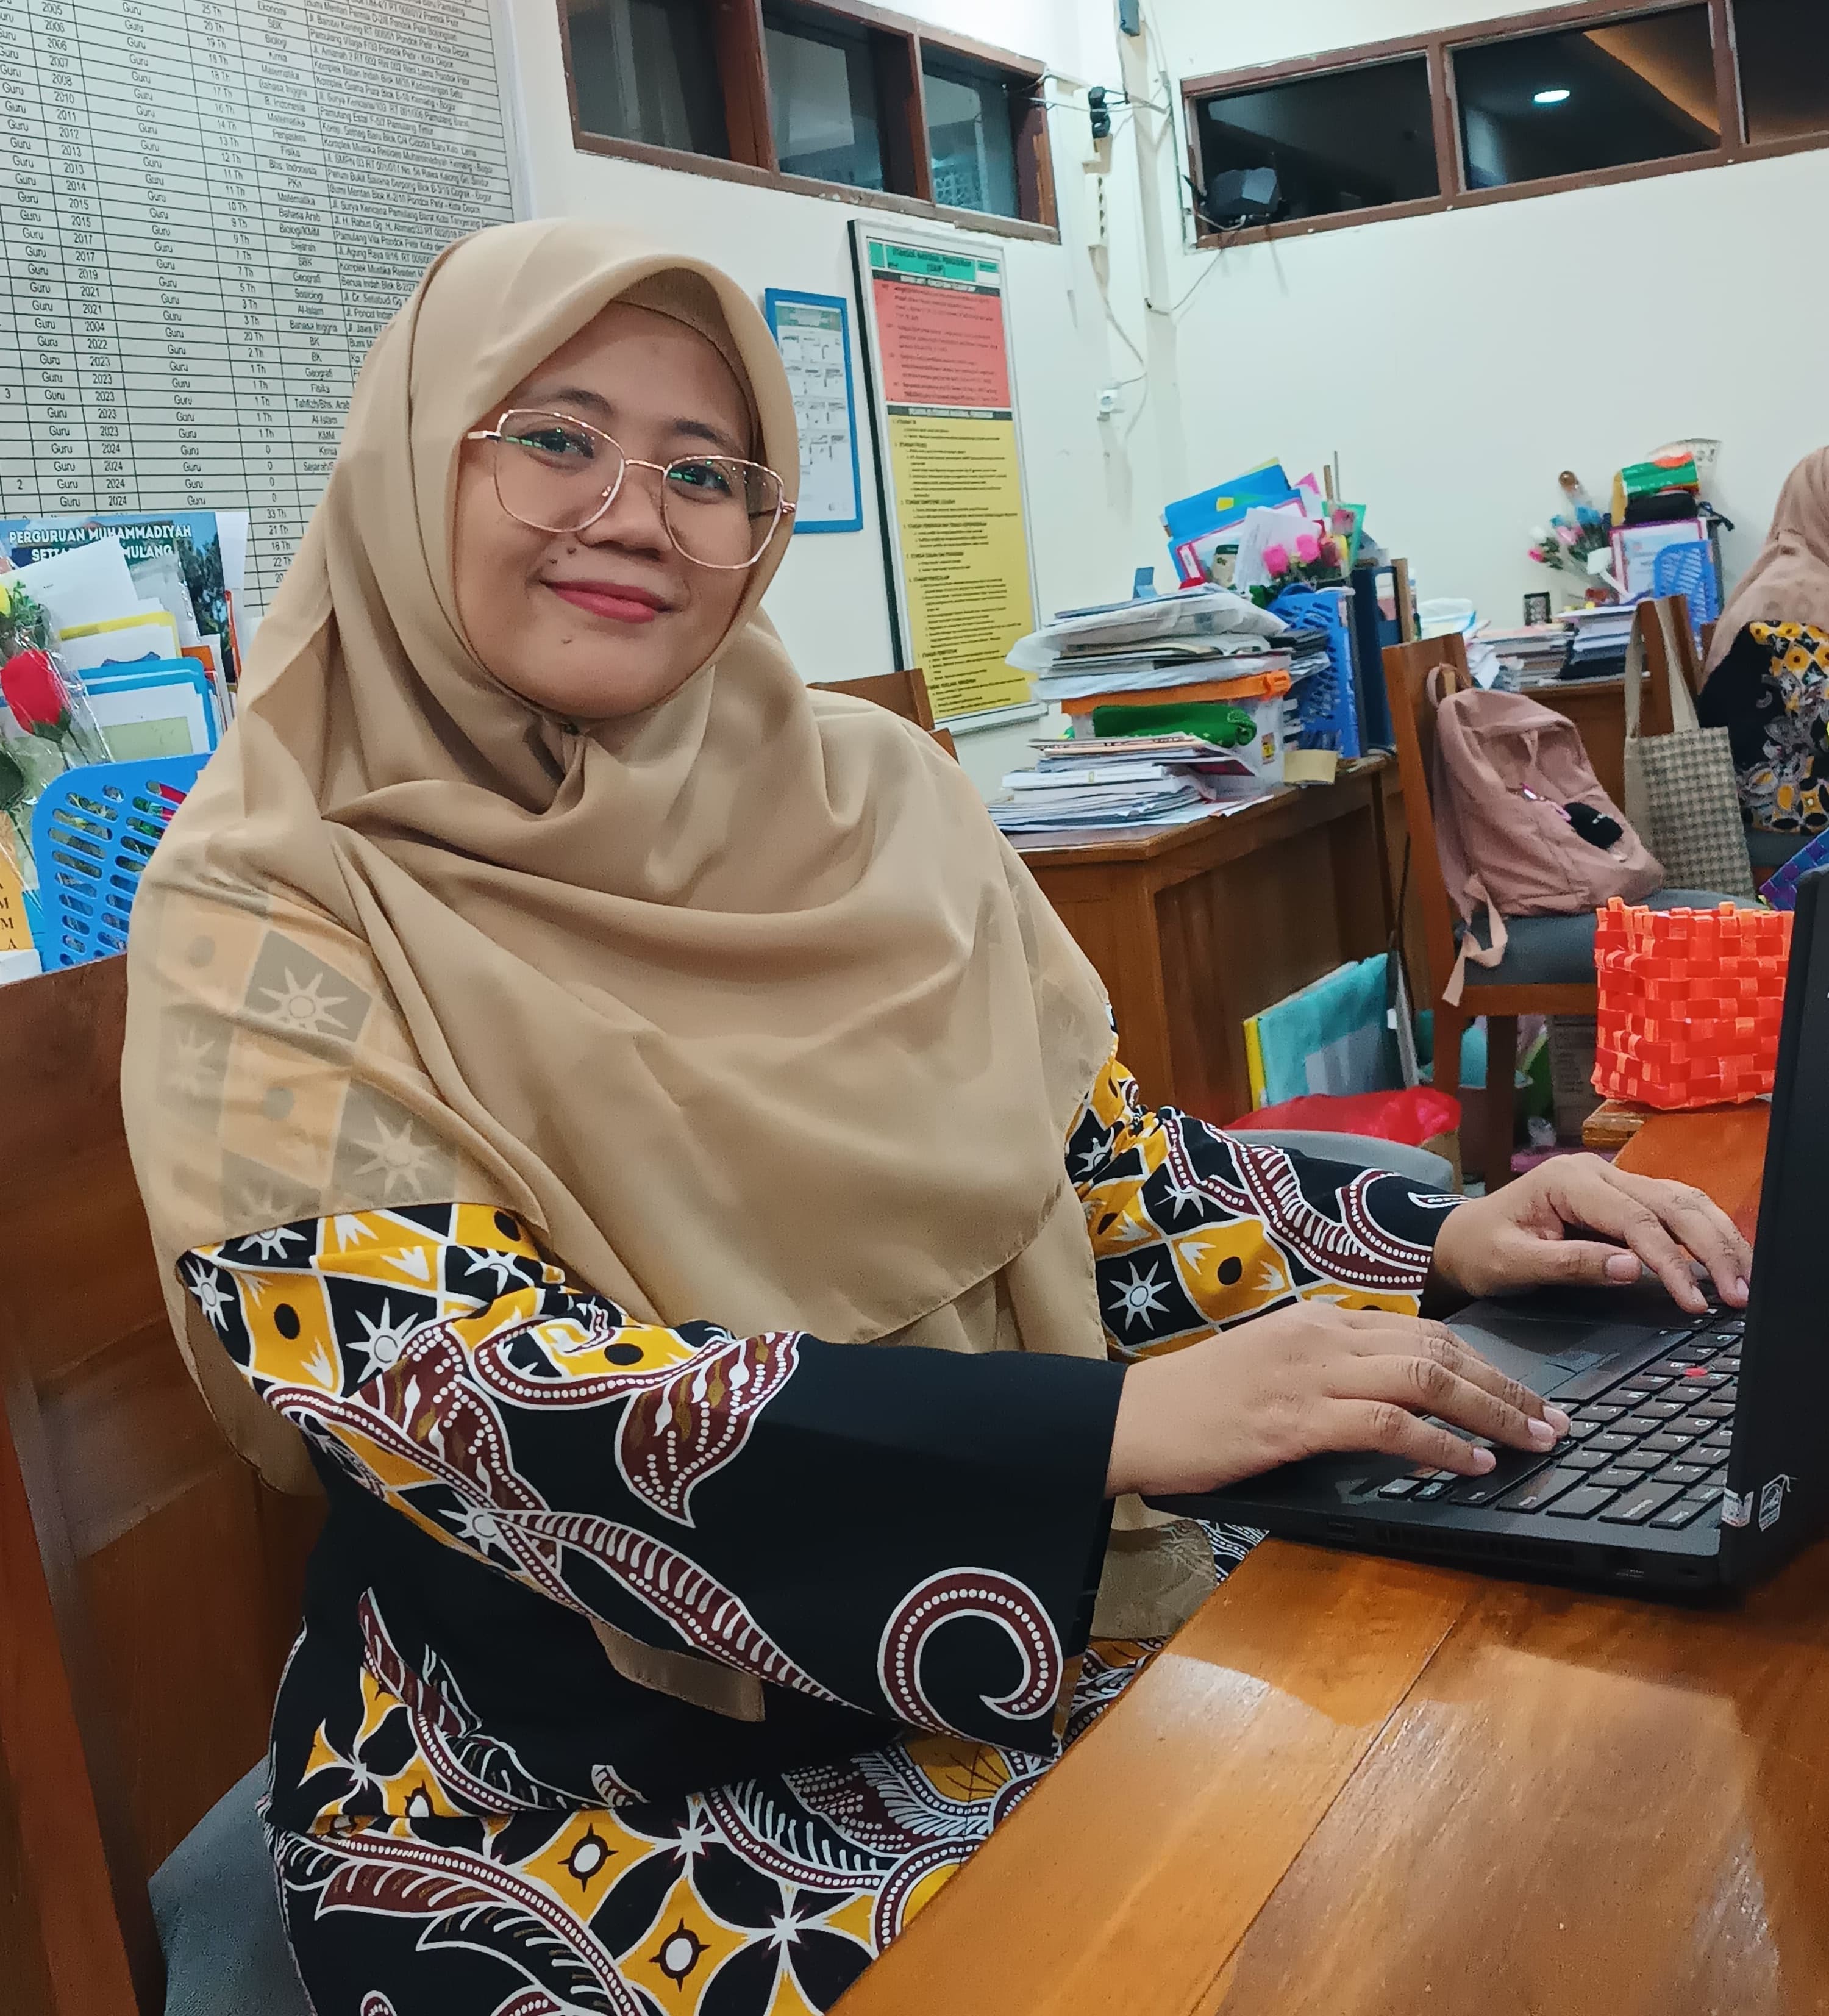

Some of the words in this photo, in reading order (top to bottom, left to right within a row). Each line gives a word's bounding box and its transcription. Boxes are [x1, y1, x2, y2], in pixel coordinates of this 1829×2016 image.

[122, 2, 141, 15] Guru
[125, 20, 143, 32] Guru
[127, 37, 146, 49] Guru
[130, 54, 148, 66] Guru
[0, 64, 21, 77] Guru
[52, 73, 73, 87] 2008
[132, 71, 151, 84] Guru
[2, 82, 24, 95] Guru
[134, 88, 152, 101] Guru
[54, 91, 74, 104] 2010
[5, 100, 26, 113] Guru
[136, 105, 155, 117] Guru
[57, 109, 76, 121] 2011
[7, 119, 29, 132] Guru
[138, 123, 157, 134] Guru
[59, 127, 79, 139] 2012
[10, 137, 31, 150] Guru
[141, 140, 159, 151] Guru
[61, 145, 82, 157] 2013
[12, 155, 34, 168] Guru
[143, 156, 162, 168] Guru
[63, 162, 84, 174] 2013
[15, 173, 36, 185] Guru
[145, 174, 164, 185] Guru
[66, 180, 86, 191] 2014
[18, 191, 38, 204] Guru
[148, 190, 166, 202] Guru
[68, 198, 89, 210] 2015
[20, 209, 41, 222] Guru
[149, 207, 168, 219] Guru
[71, 215, 91, 227] 2015
[23, 227, 44, 240] Guru
[152, 225, 170, 236] Guru
[73, 232, 93, 245] 2017
[25, 245, 46, 258] Guru
[154, 241, 173, 253] Guru
[75, 251, 95, 262] 2017
[28, 263, 49, 275] Guru
[156, 259, 175, 270] Guru
[78, 268, 98, 280] 2019
[30, 281, 51, 293] Guru
[159, 276, 177, 288] Guru
[80, 286, 100, 298] 2021
[161, 293, 179, 304] Guru
[32, 300, 53, 312] Guru
[82, 303, 102, 315] 2021
[163, 310, 182, 321] Guru
[35, 317, 56, 329] Guru
[85, 321, 105, 332] 2004
[165, 327, 184, 338] Guru
[37, 335, 58, 347] Guru
[87, 338, 108, 349] 2022
[168, 344, 186, 355] Guru
[40, 353, 60, 365] Guru
[90, 356, 110, 366] 2023
[169, 360, 188, 371] Guru
[41, 371, 63, 382] Guru
[92, 373, 112, 385] 2023
[172, 378, 190, 388] Guru
[5, 388, 11, 399] 3
[45, 389, 65, 401] Guru
[95, 391, 115, 402] 2023
[174, 395, 192, 405] Guru
[47, 407, 67, 418] Guru
[98, 408, 117, 420] 2023
[176, 411, 194, 422] Guru
[49, 425, 70, 436] Guru
[99, 426, 119, 437] 2023
[179, 428, 197, 438] Guru
[51, 443, 73, 454] Guru
[102, 443, 121, 454] 2024
[180, 445, 199, 456] Guru
[54, 461, 76, 472] Guru
[104, 460, 123, 471] 2024
[183, 462, 201, 472] Guru
[17, 479, 23, 490] 2
[57, 478, 78, 489] Guru
[105, 478, 125, 490] 2024
[185, 479, 203, 488] Guru
[60, 496, 80, 507] Guru
[108, 495, 127, 506] 2024
[187, 495, 205, 506] Guru
[9, 528, 85, 543] PERGURUAN
[88, 524, 192, 541] MUHAMMADIYAH
[123, 544, 172, 559] MULANG
